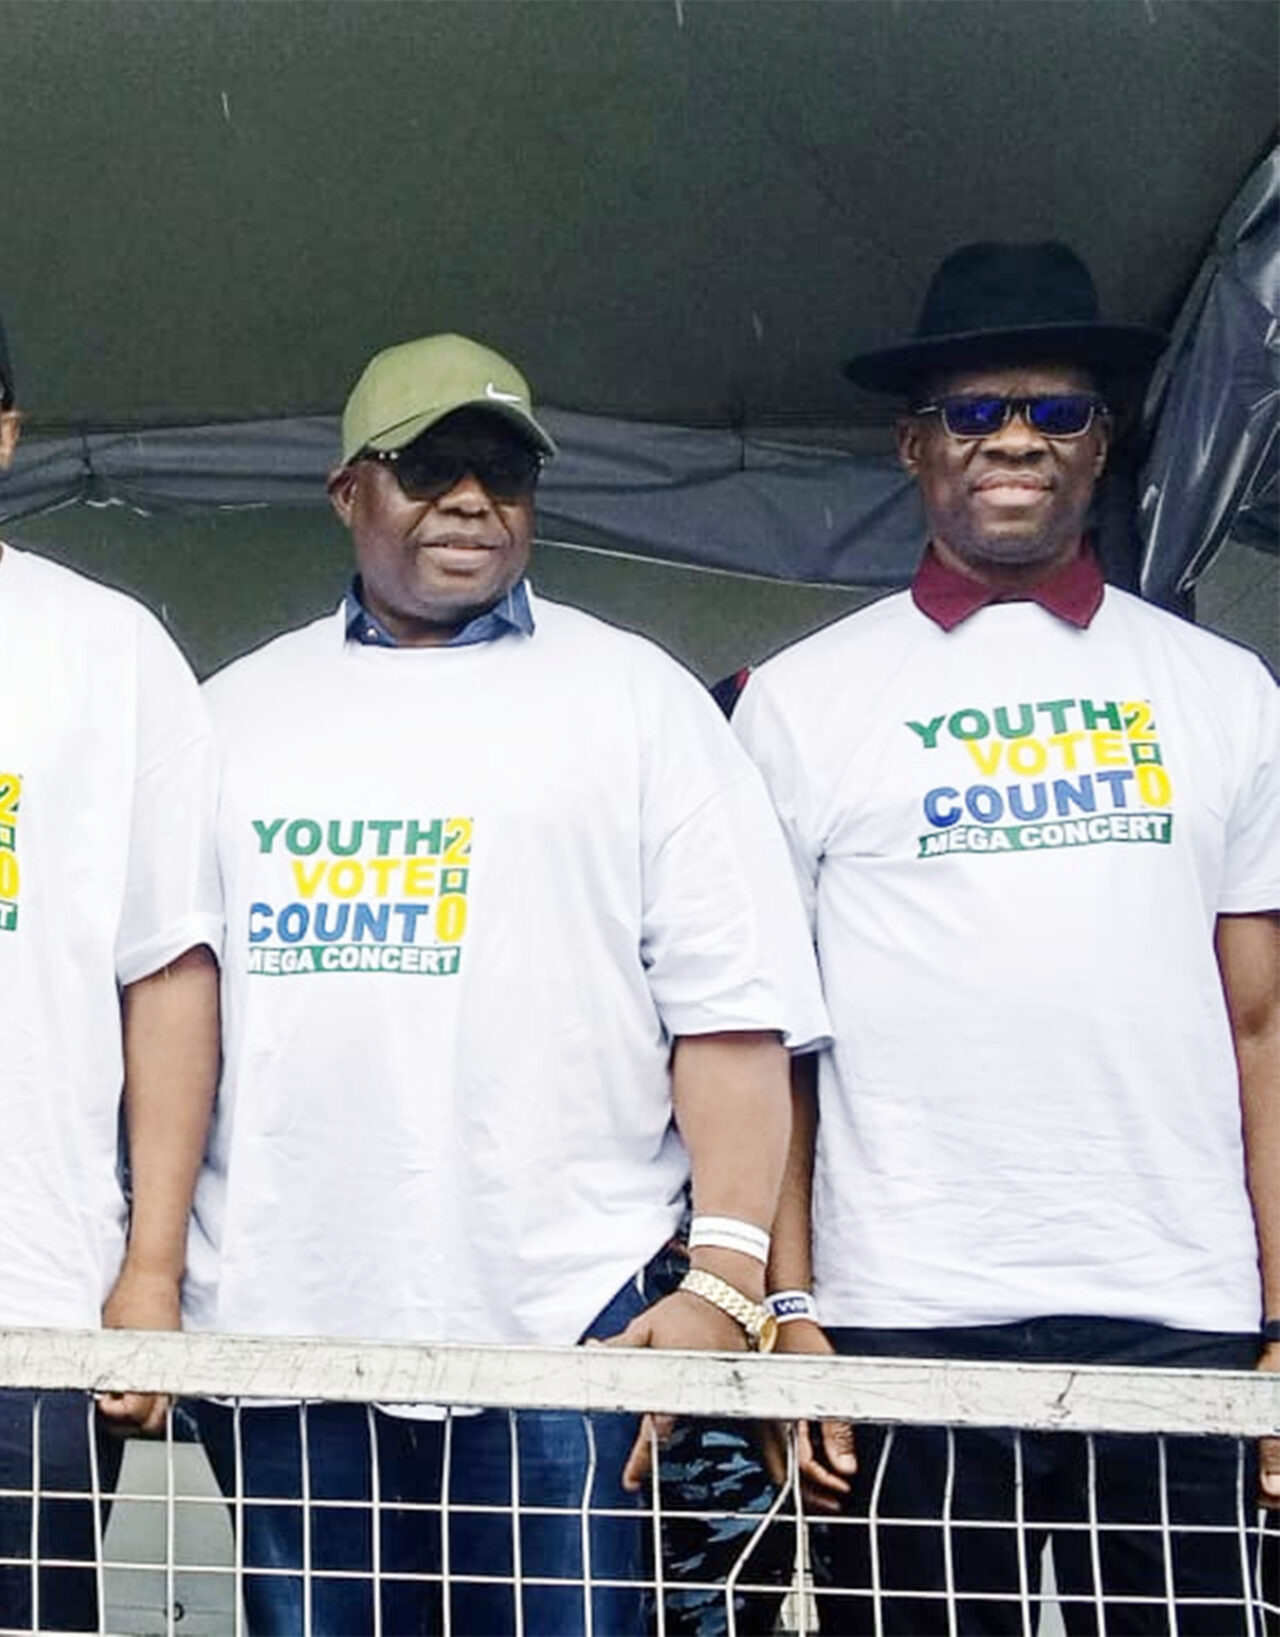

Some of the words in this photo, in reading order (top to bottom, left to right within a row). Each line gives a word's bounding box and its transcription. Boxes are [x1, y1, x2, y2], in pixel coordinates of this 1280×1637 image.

[904, 698, 1123, 749] YOUTH
[965, 731, 1129, 777] VOTE
[923, 770, 1134, 828] COUNT
[251, 818, 443, 856] YOUTH
[924, 827, 1013, 855] MEGA
[1019, 815, 1168, 847] CONCERT
[291, 858, 436, 899] VOTE
[248, 902, 429, 943] COUNT
[321, 946, 458, 973] CONCERT
